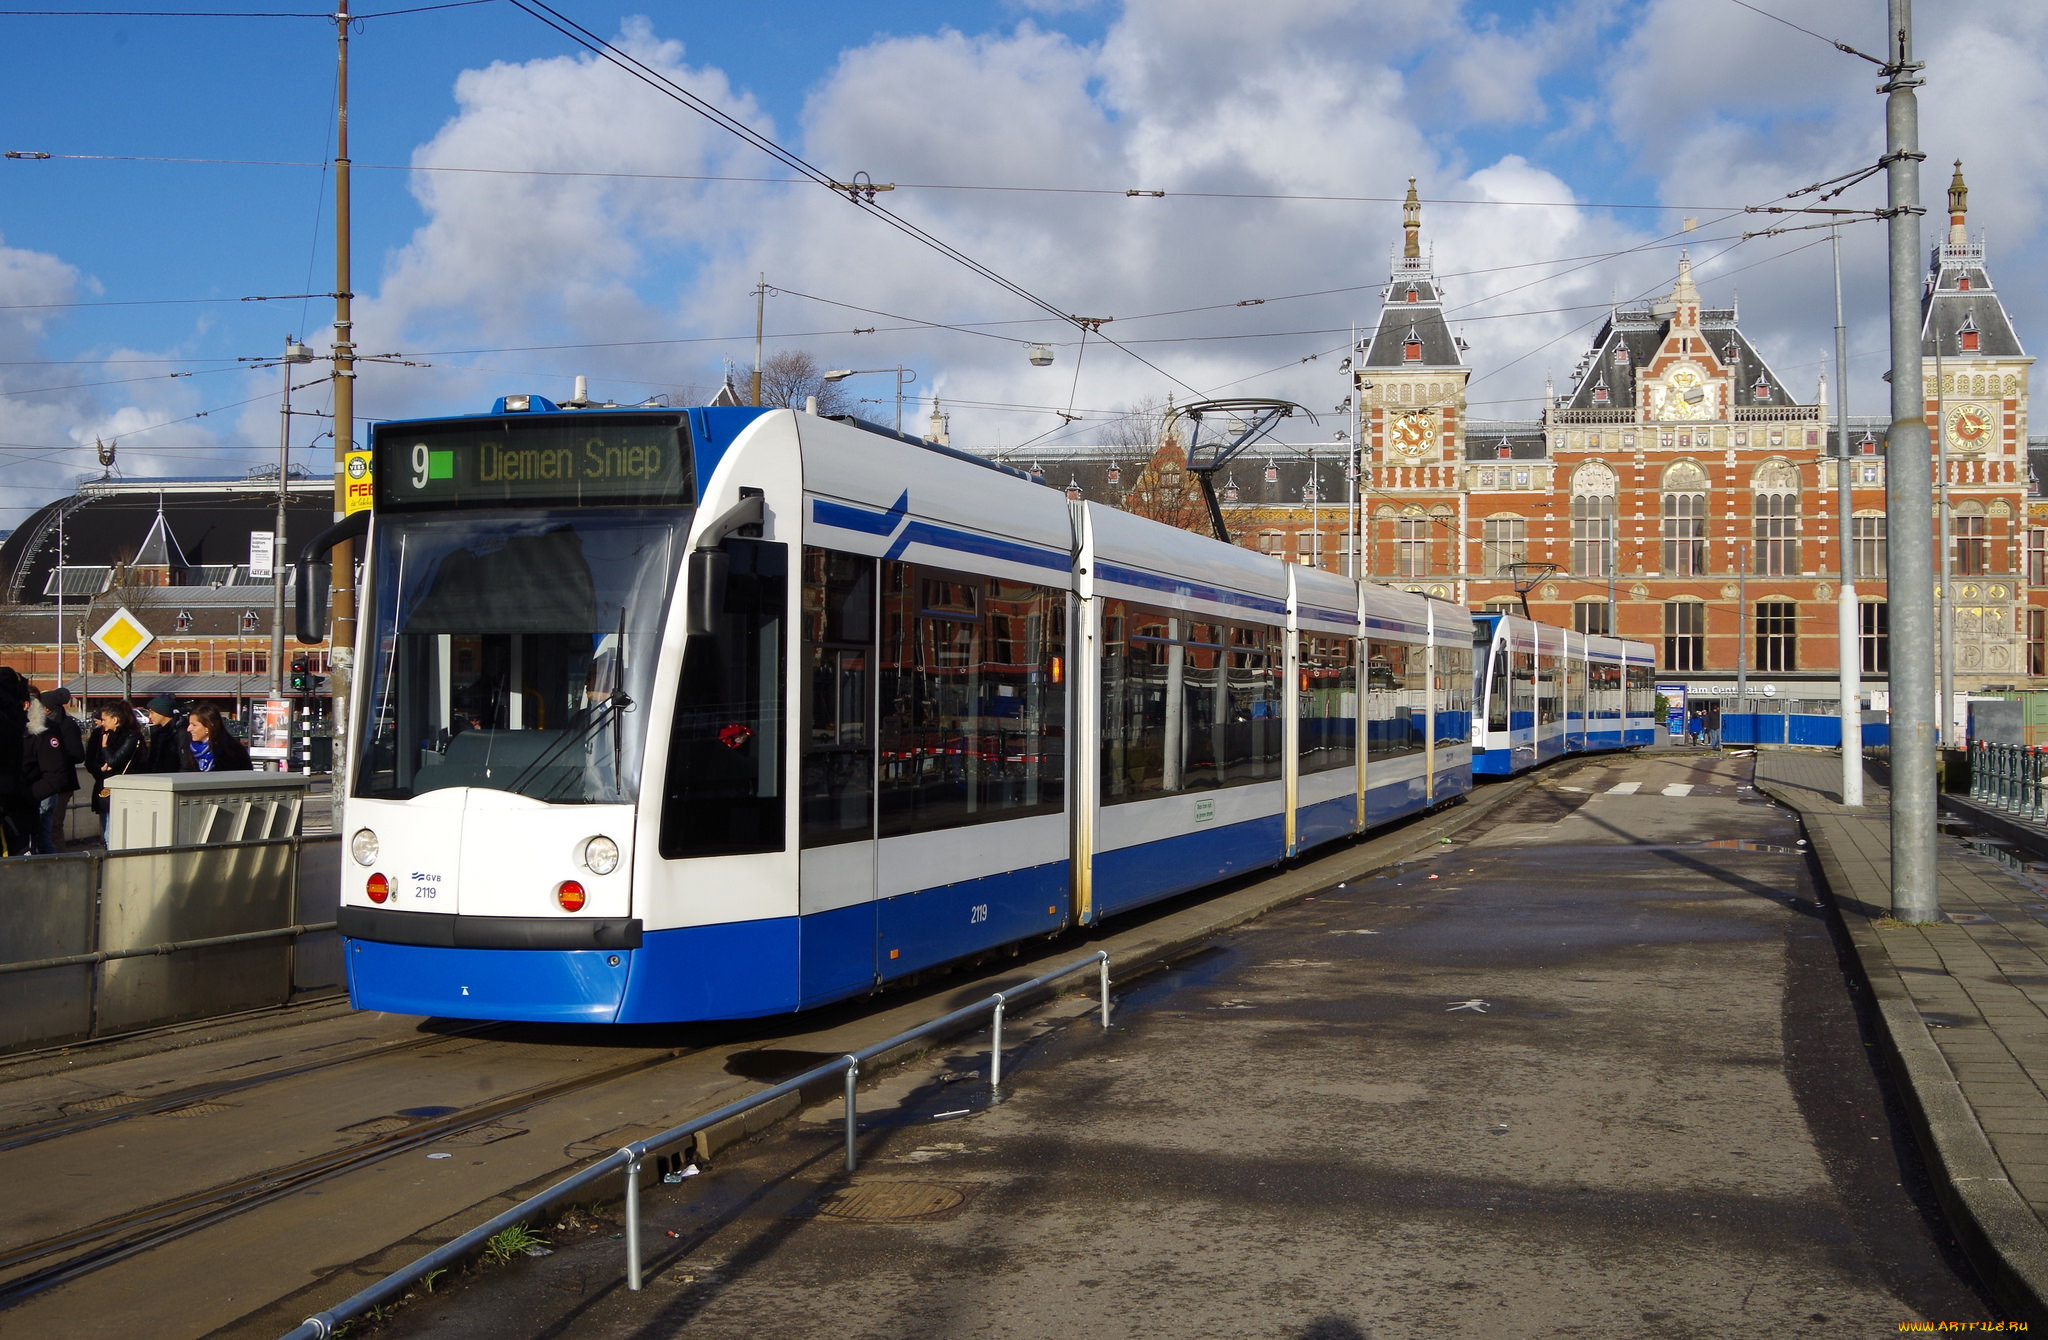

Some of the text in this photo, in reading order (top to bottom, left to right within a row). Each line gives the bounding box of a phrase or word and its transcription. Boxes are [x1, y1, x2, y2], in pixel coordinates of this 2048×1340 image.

[411, 437, 661, 489] 9 Diemen Sniep
[426, 874, 442, 882] GVB
[415, 886, 437, 899] 2119
[970, 903, 988, 924] 2119
